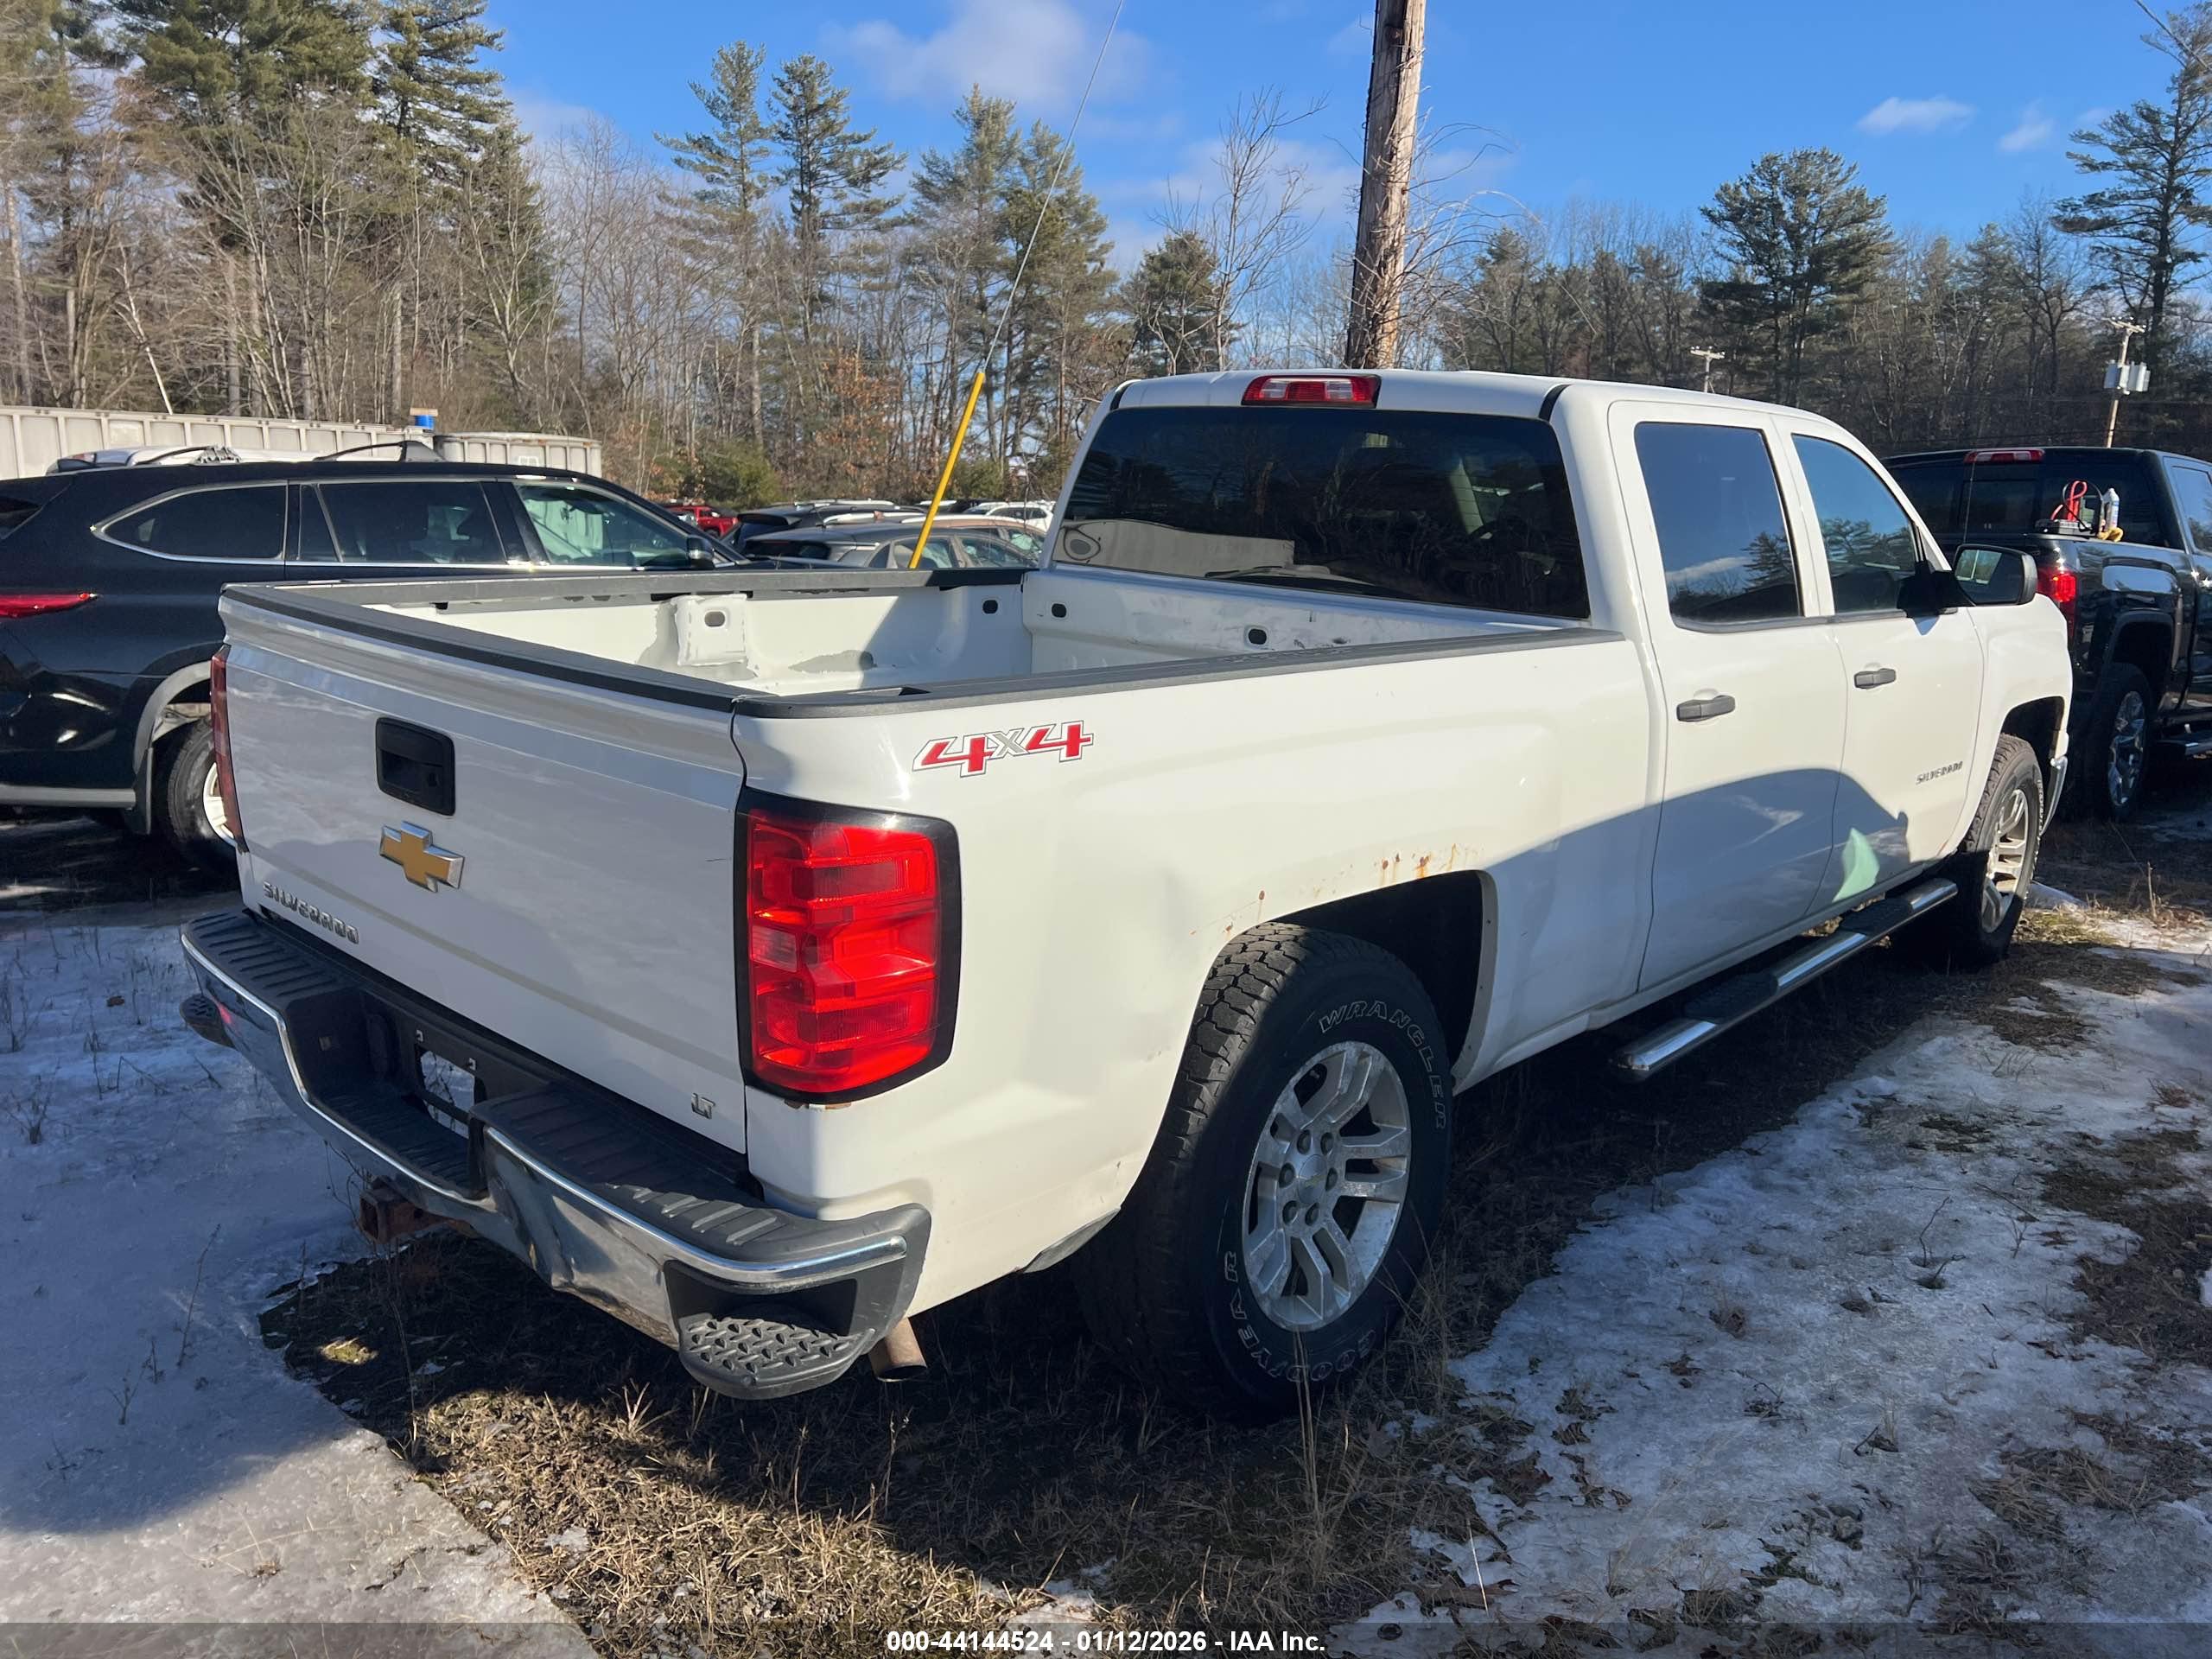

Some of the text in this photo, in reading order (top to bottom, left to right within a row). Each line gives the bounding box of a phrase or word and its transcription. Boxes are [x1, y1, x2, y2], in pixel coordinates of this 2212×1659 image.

[263, 881, 359, 944] SILVERADO
[691, 1092, 715, 1120] LT
[1319, 1001, 1446, 1130] WRANGLER
[1224, 1250, 1376, 1382] GOODYEAR
